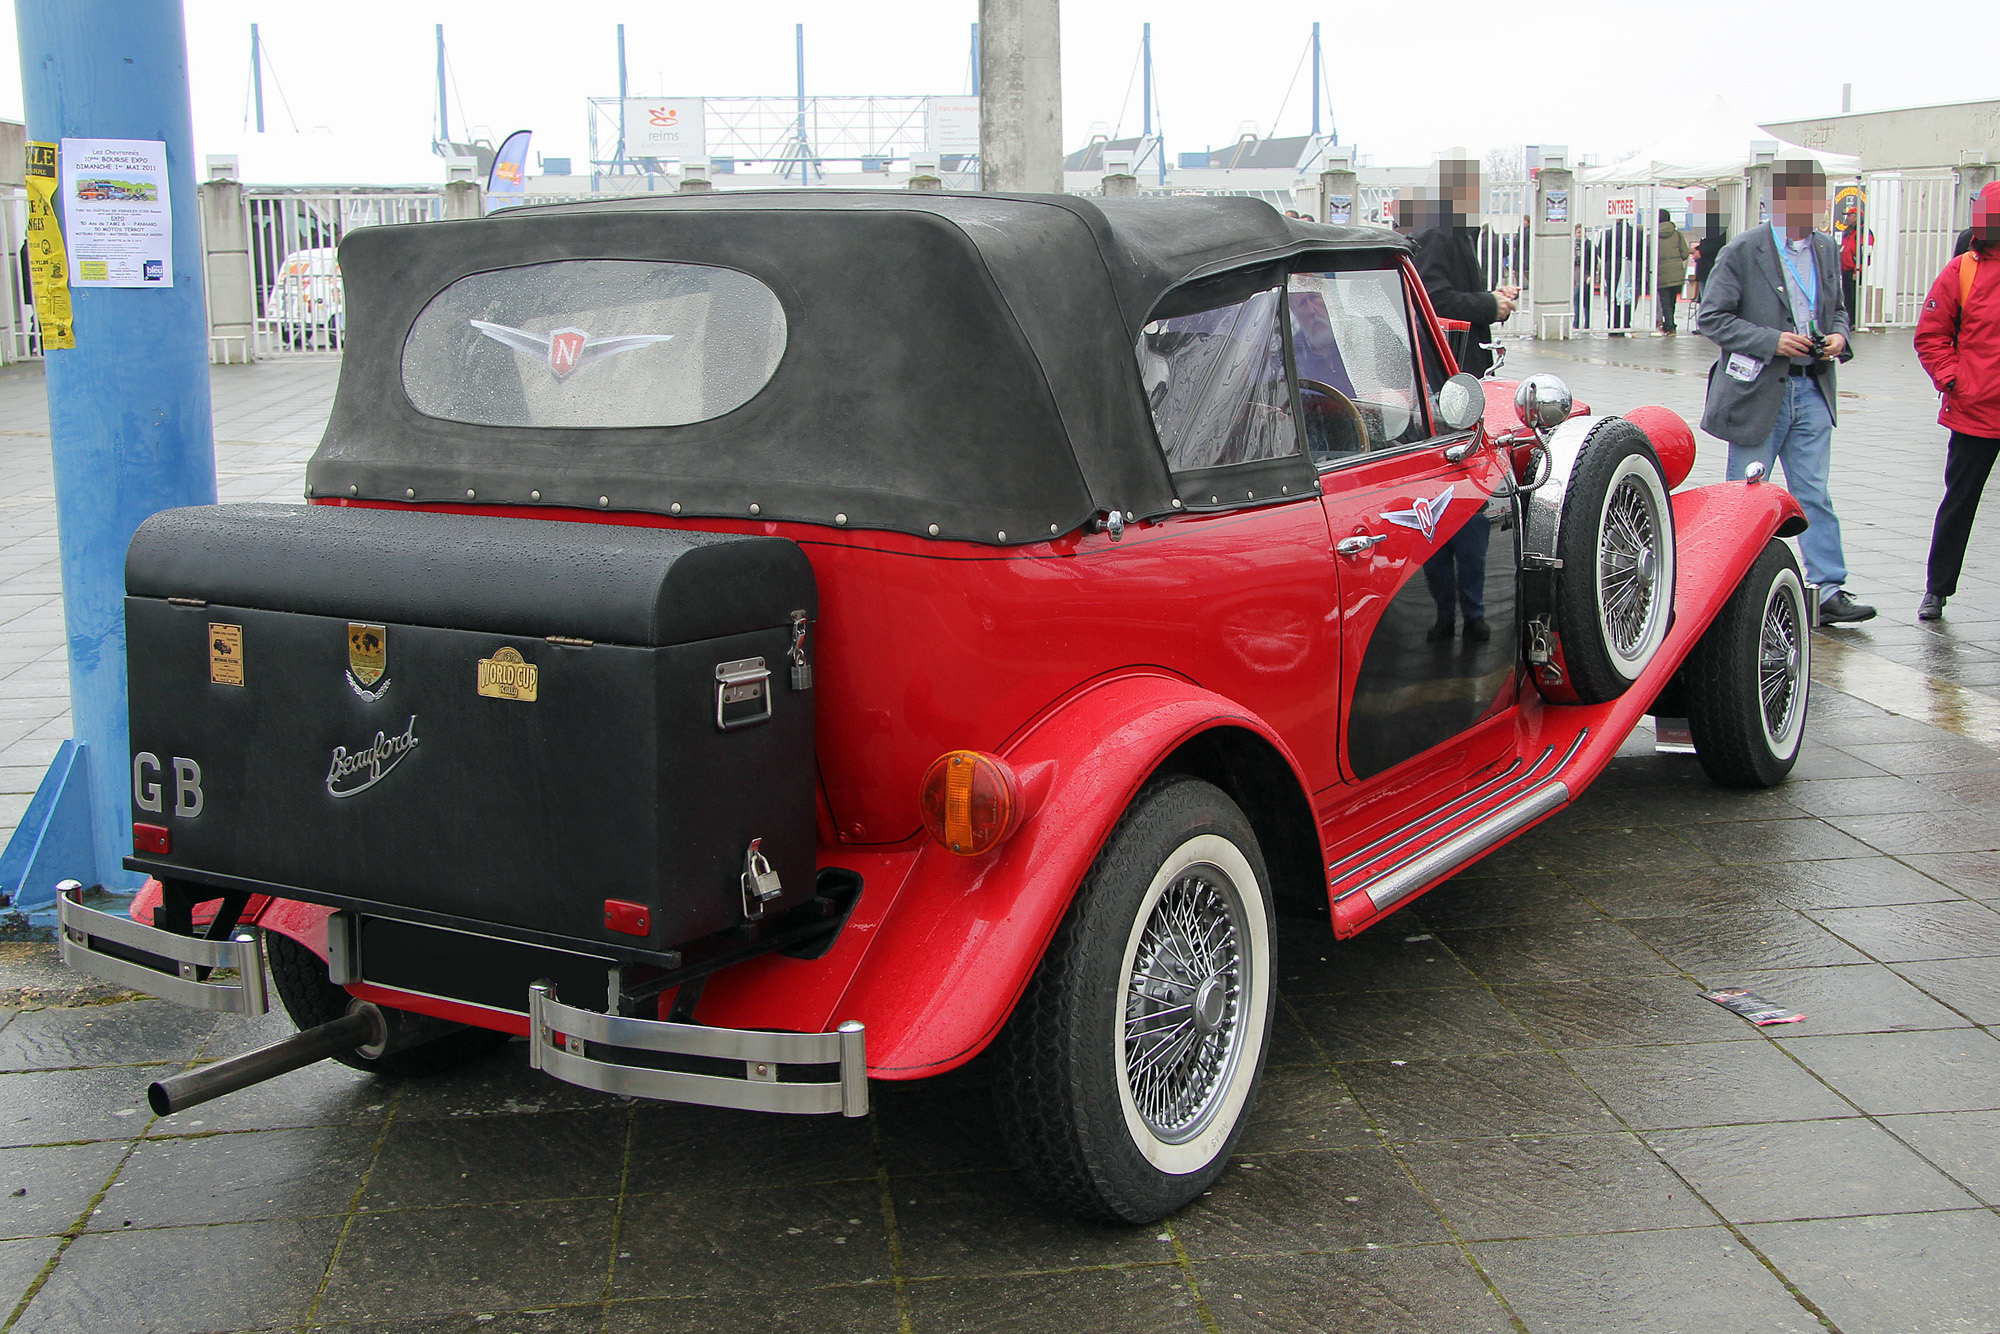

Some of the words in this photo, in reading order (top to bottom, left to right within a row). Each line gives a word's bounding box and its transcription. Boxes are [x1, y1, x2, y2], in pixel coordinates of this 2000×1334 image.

[648, 130, 679, 141] reims
[1608, 200, 1634, 215] ENTREE
[556, 338, 577, 366] N
[1418, 506, 1432, 528] N
[481, 663, 515, 688] WORLD
[517, 667, 536, 692] CUP
[500, 684, 518, 698] Rally
[326, 714, 418, 798] Beauford
[134, 751, 204, 818] GB
